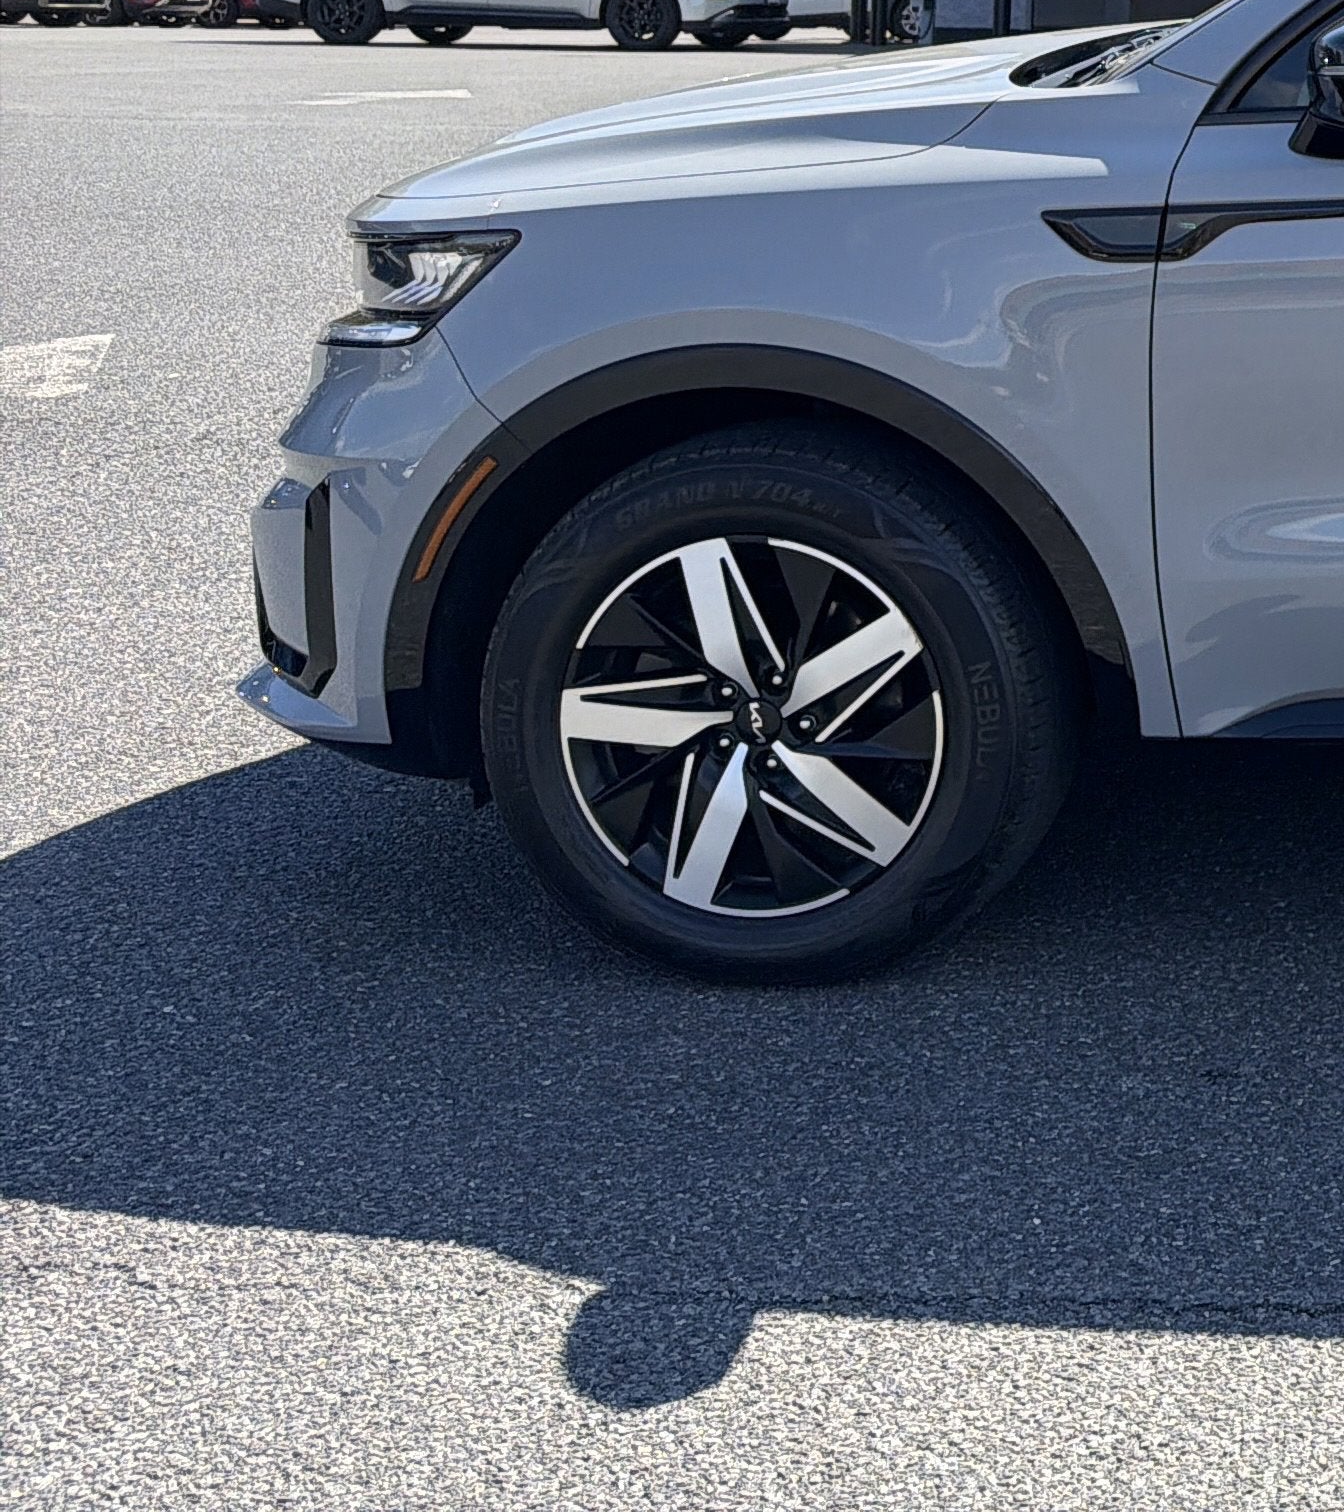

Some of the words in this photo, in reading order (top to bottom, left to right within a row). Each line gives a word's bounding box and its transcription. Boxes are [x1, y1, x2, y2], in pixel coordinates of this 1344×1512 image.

[752, 479, 813, 508] 704
[498, 678, 528, 792] EBULA
[748, 701, 767, 744] KIA
